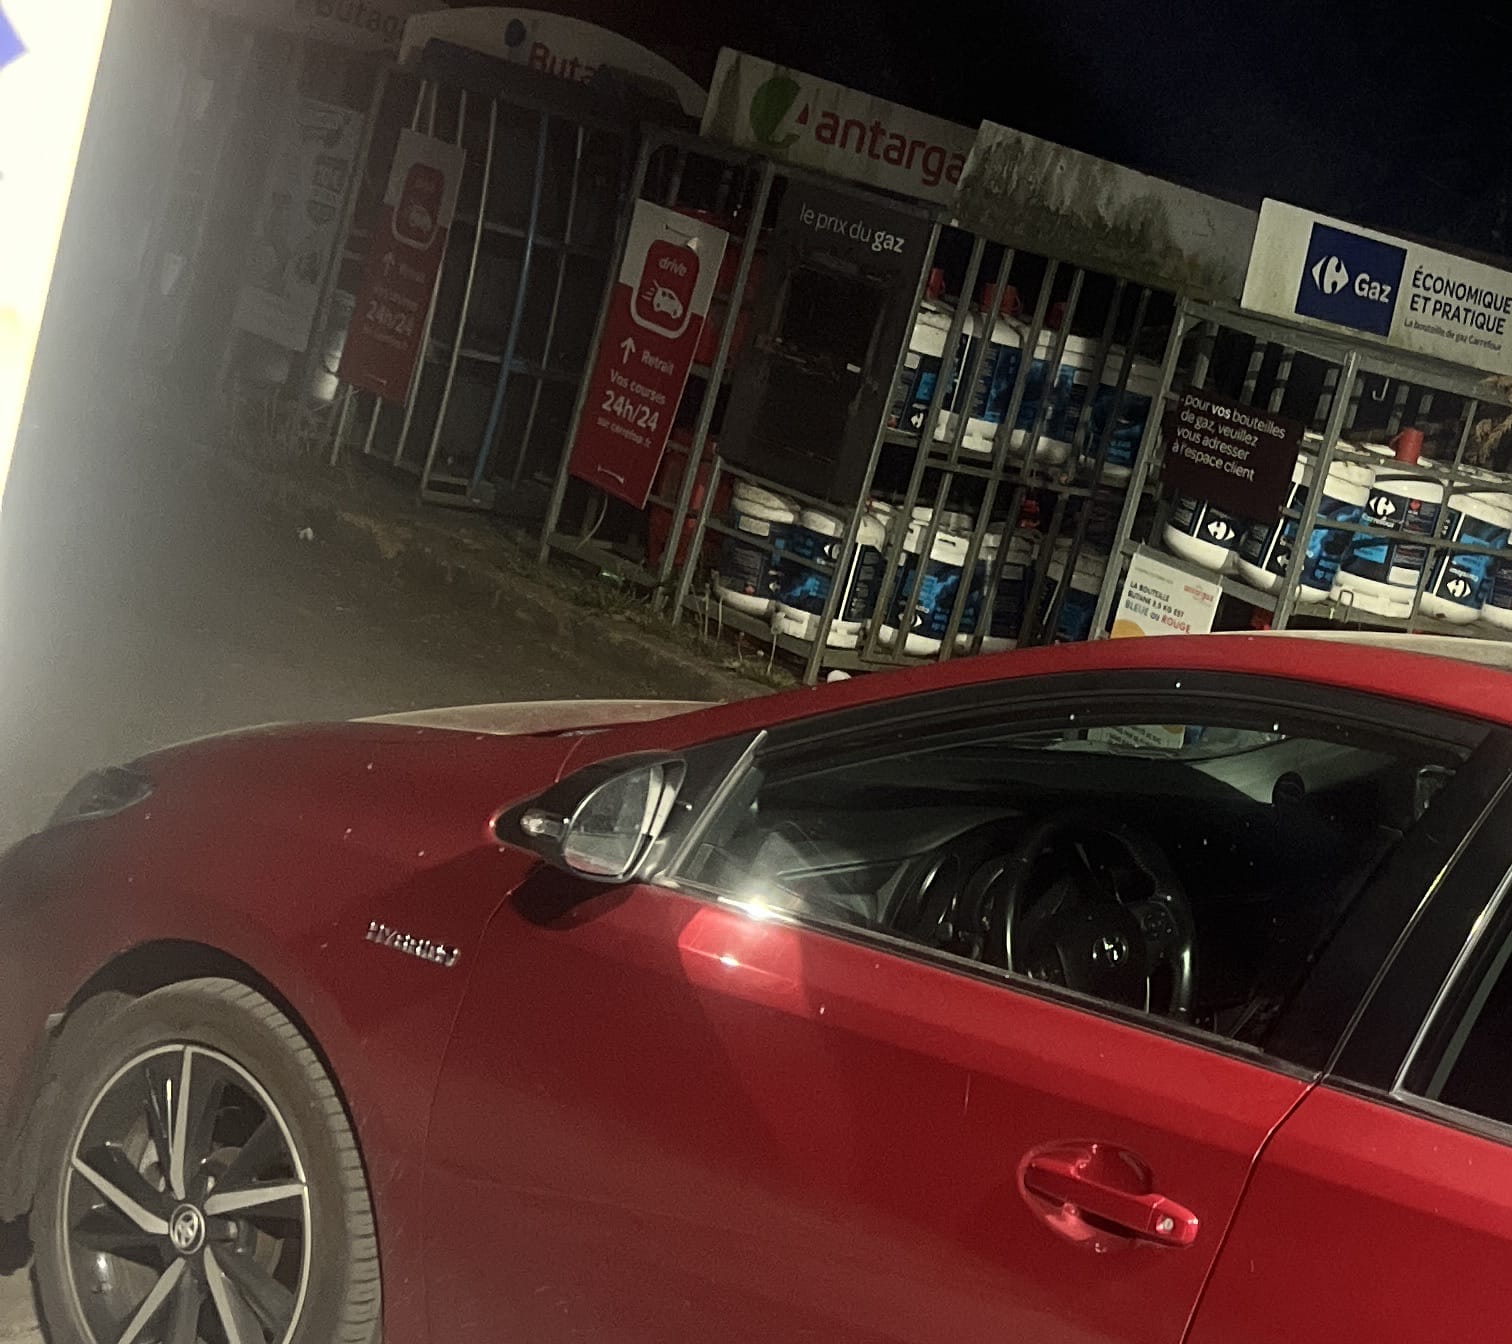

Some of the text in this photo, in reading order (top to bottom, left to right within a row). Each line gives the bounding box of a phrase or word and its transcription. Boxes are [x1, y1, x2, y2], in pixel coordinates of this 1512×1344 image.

[815, 211, 849, 236] prix
[849, 220, 872, 243] du
[871, 230, 906, 254] gaz
[658, 256, 689, 277] drive
[1354, 272, 1392, 305] Gaz
[1410, 293, 1506, 336] ET PRATIQUE
[641, 349, 675, 376] Retrait
[610, 368, 667, 405] Vos courses
[601, 389, 660, 433] 24h/24
[1180, 408, 1195, 424] de
[1218, 423, 1258, 447] veuillez
[1184, 394, 1286, 440] pour vos bouteilles
[1171, 437, 1180, 453] à
[1223, 460, 1255, 482] client
[1176, 425, 1250, 461] vous adresser
[1130, 581, 1138, 589] LA
[1125, 599, 1149, 617] BLEUE
[1161, 614, 1192, 634] ROUGE
